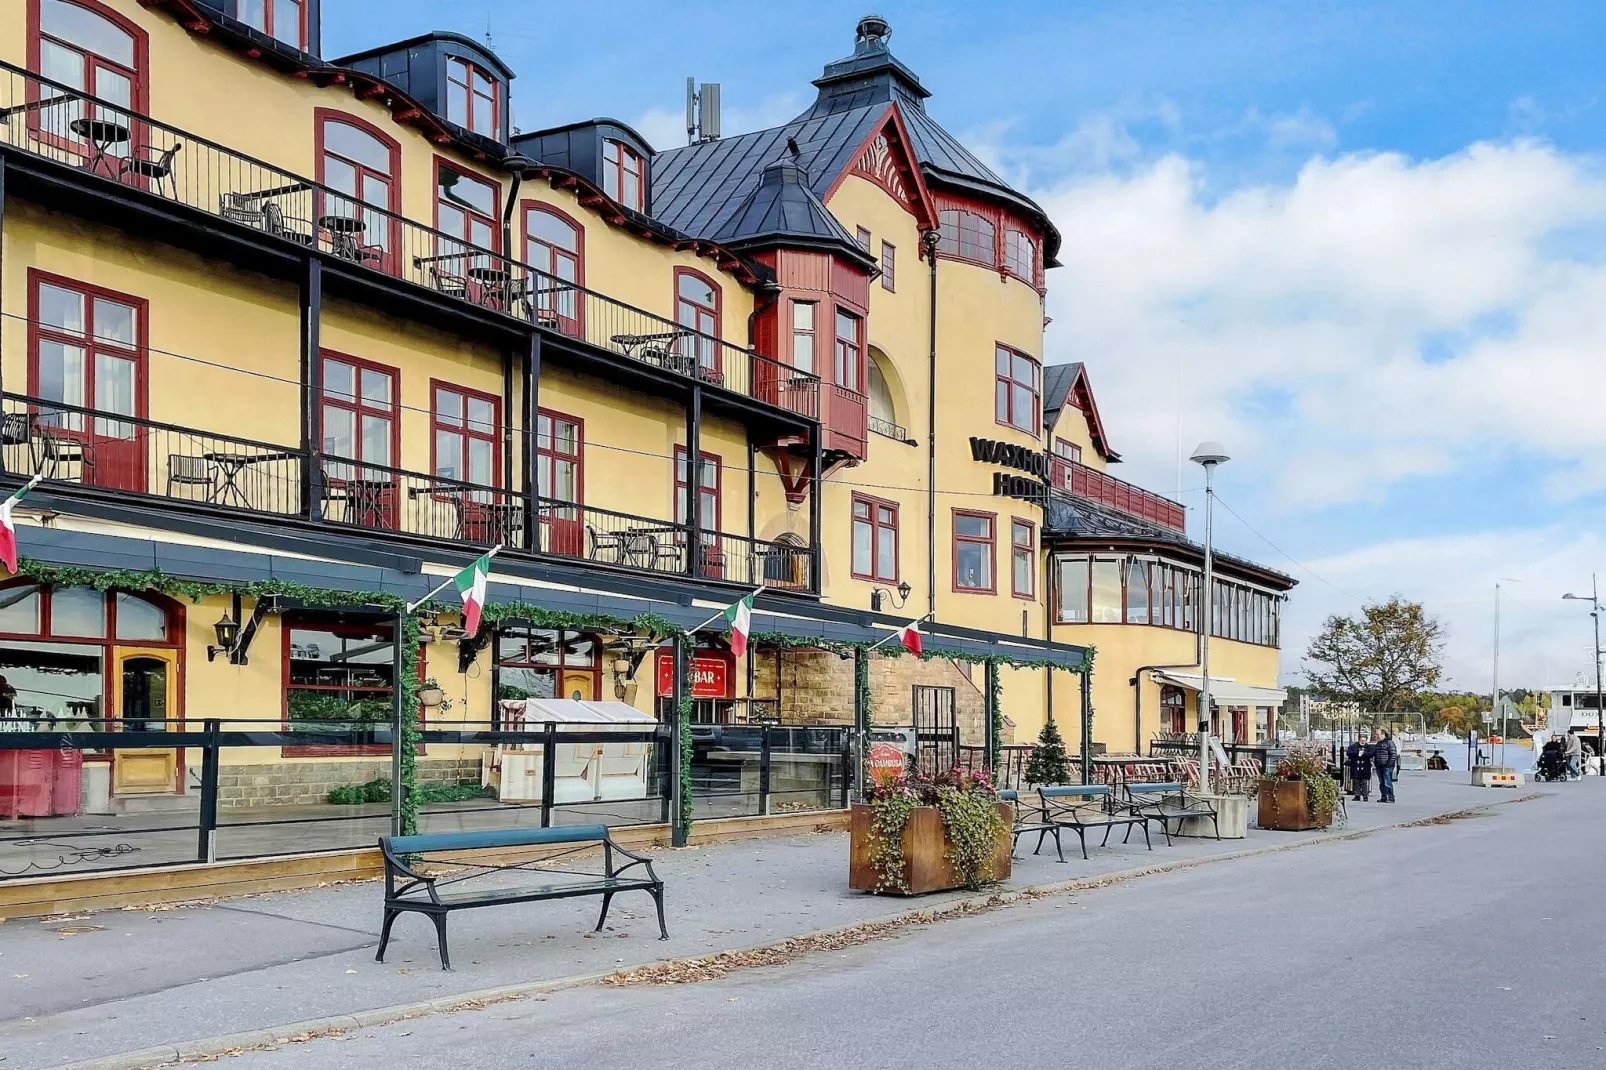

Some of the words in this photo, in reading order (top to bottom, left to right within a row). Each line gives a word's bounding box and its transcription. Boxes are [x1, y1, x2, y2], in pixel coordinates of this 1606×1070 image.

[969, 437, 1051, 486] WAXHOL
[993, 472, 1049, 509] HOTEL
[694, 670, 714, 684] BAR
